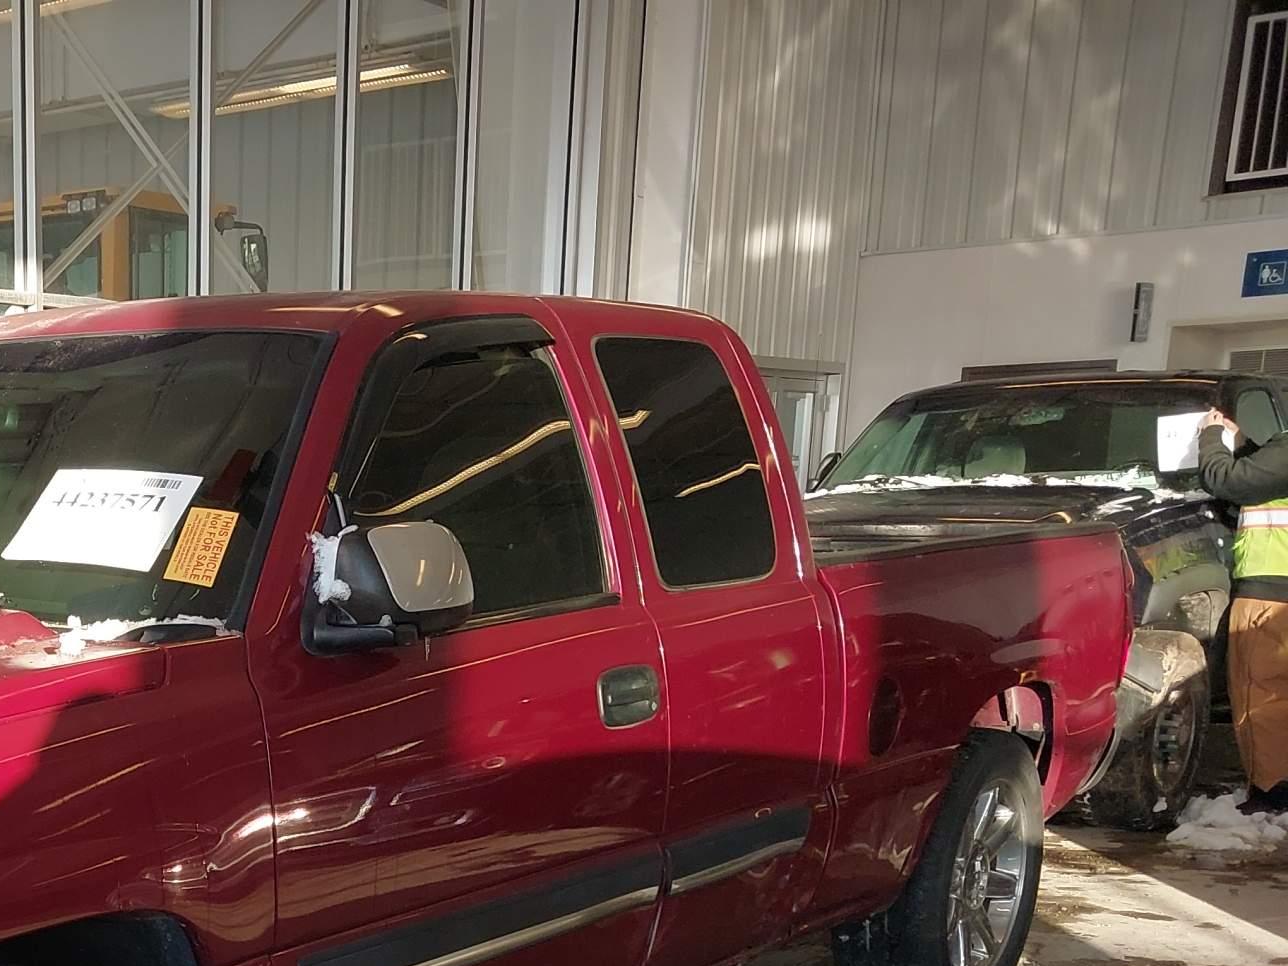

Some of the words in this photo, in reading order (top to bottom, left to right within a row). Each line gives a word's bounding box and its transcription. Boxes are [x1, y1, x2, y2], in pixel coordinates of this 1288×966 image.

[52, 491, 168, 513] 44237571
[208, 513, 223, 529] Not
[218, 515, 235, 537] THIS
[199, 531, 217, 552] FOR
[189, 553, 208, 581] SALE
[201, 540, 226, 583] VEHICLE
